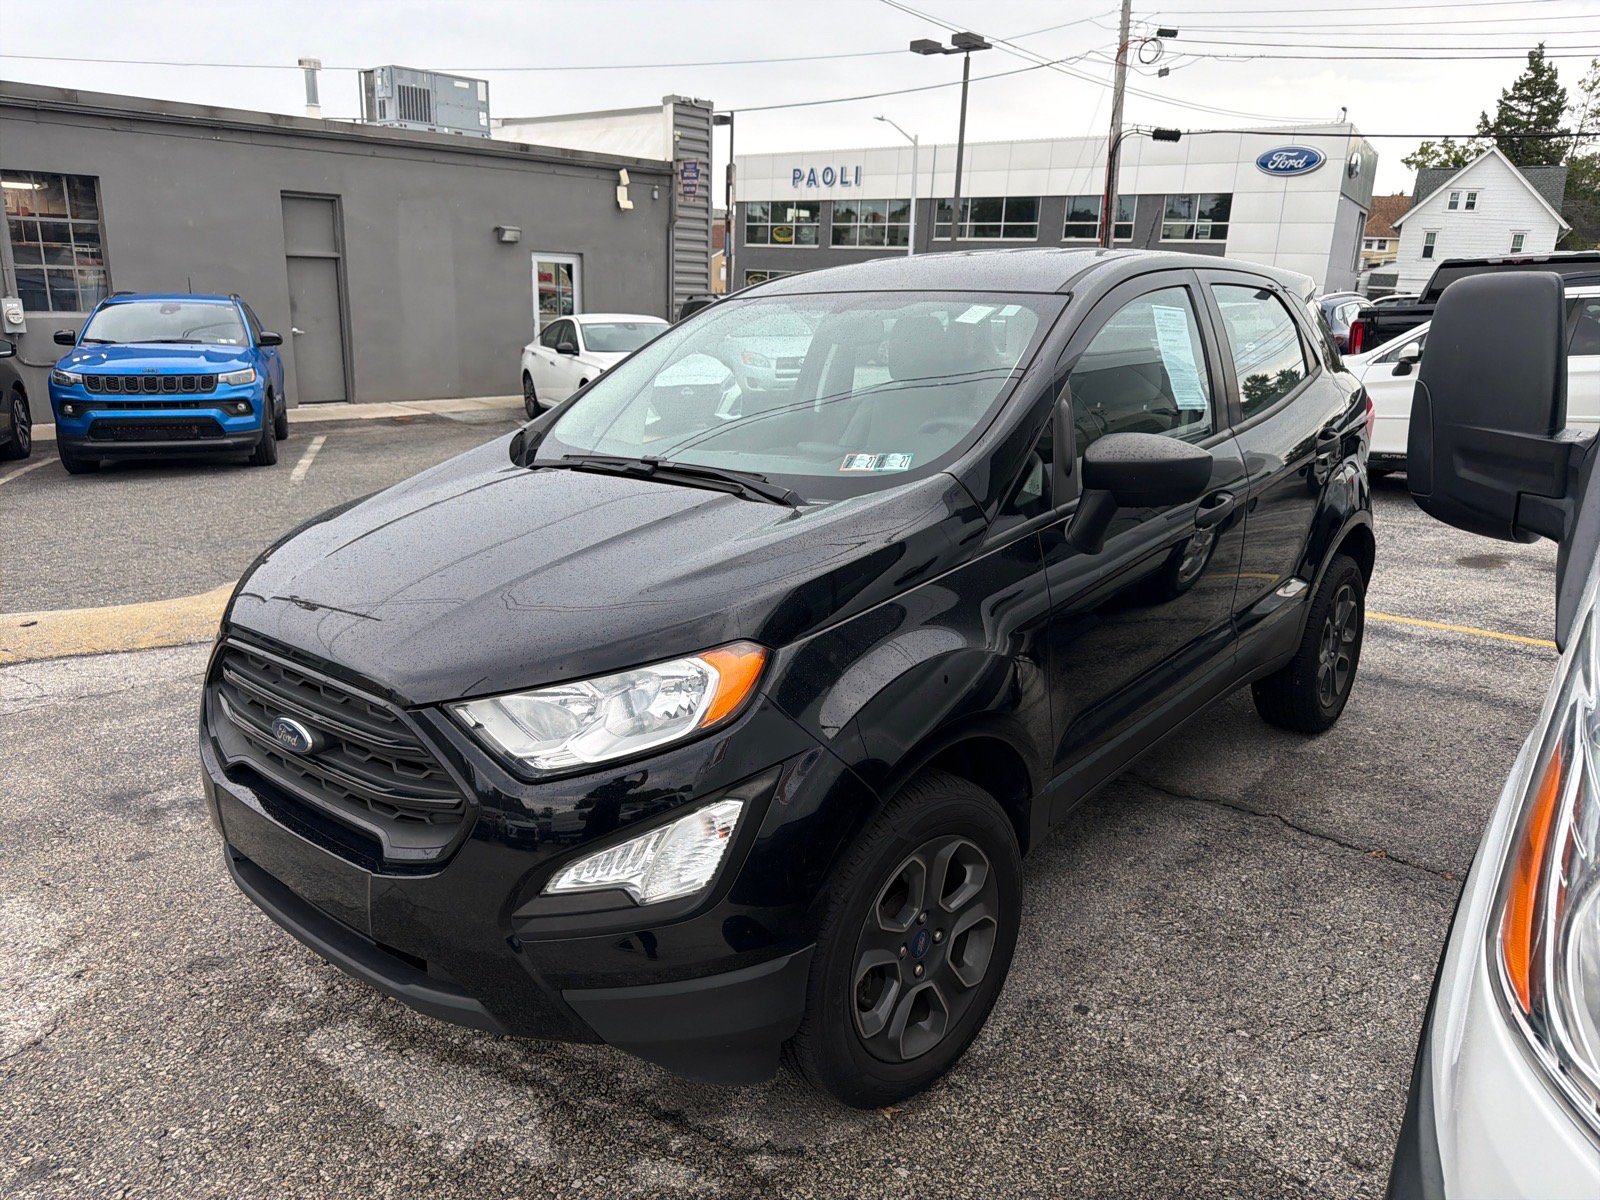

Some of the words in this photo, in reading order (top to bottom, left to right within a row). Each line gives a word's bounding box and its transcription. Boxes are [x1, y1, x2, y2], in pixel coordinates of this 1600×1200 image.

[1268, 152, 1307, 169] Ford
[792, 165, 862, 188] PAOLI
[277, 723, 298, 746] Ford
